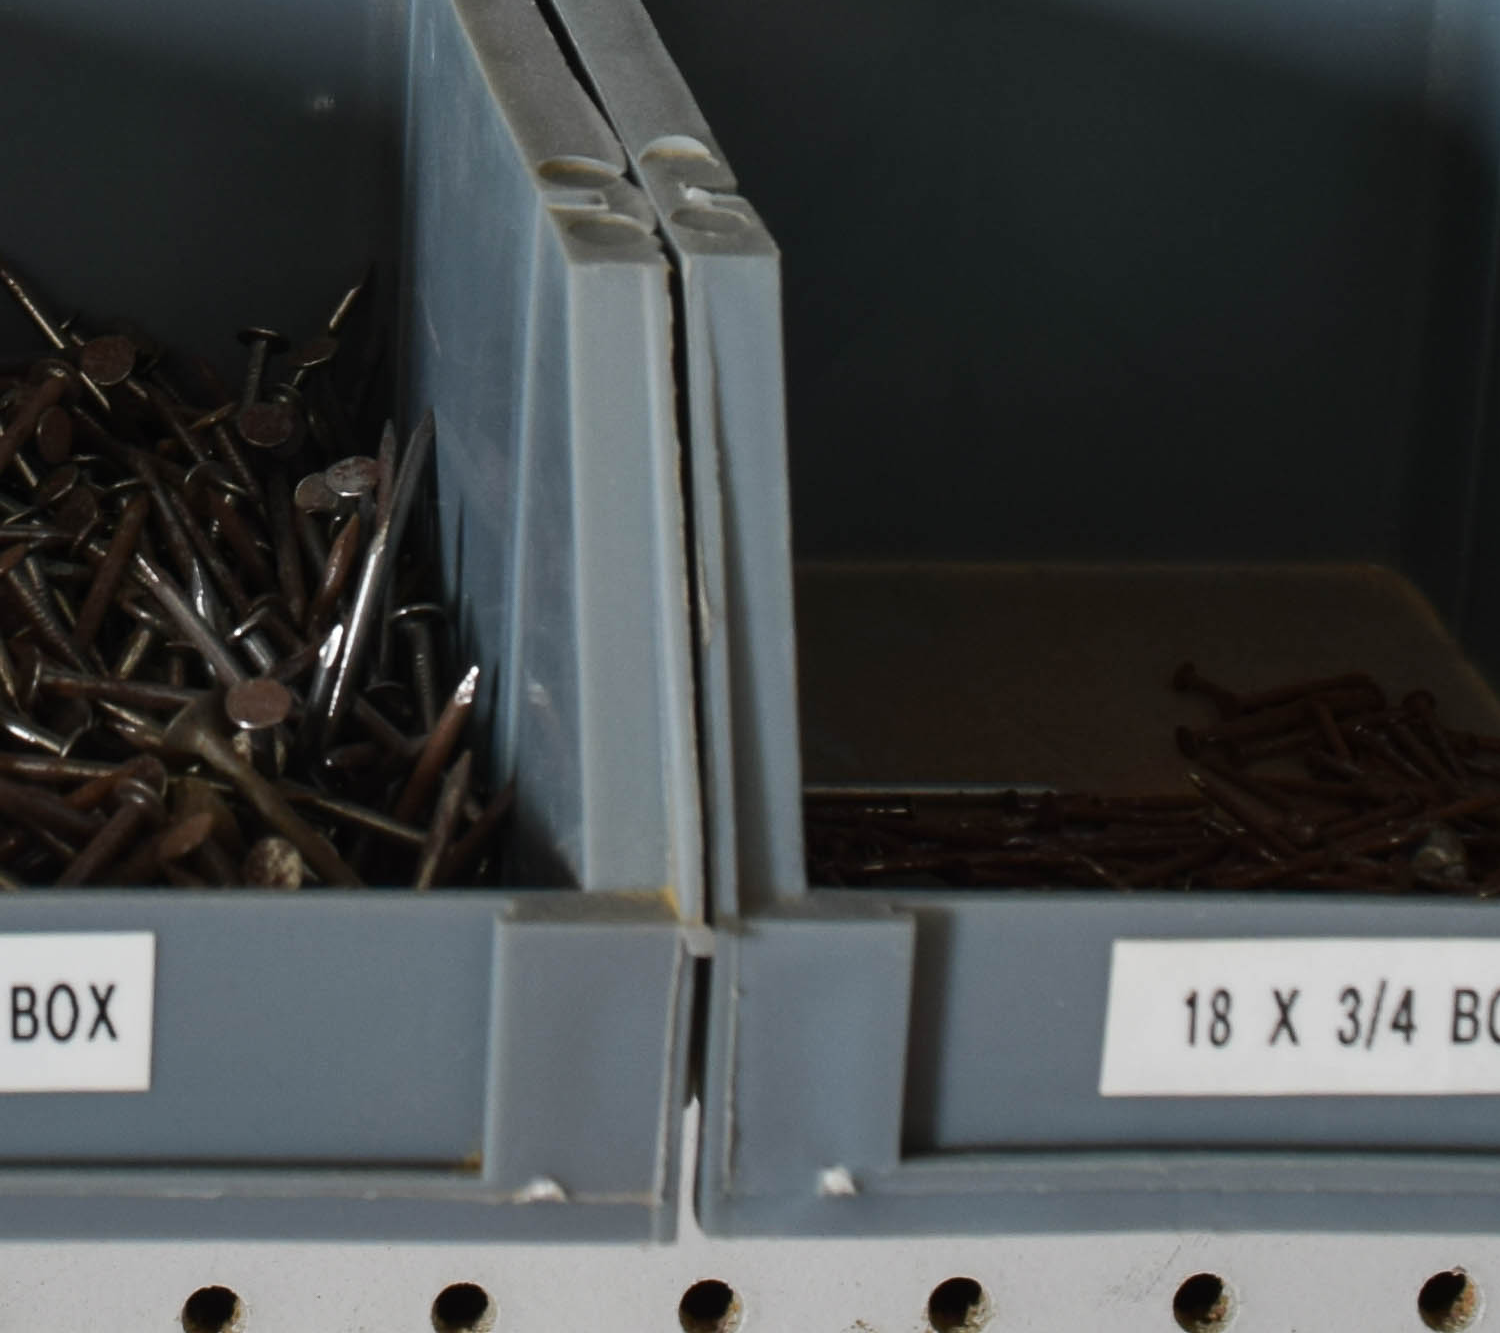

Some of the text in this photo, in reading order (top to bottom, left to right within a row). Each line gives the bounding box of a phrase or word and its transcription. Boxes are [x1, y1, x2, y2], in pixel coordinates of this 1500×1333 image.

[10, 982, 117, 1043] BOX
[1185, 988, 1232, 1048] 18
[1269, 989, 1300, 1045] X
[1337, 980, 1417, 1050] 3/4
